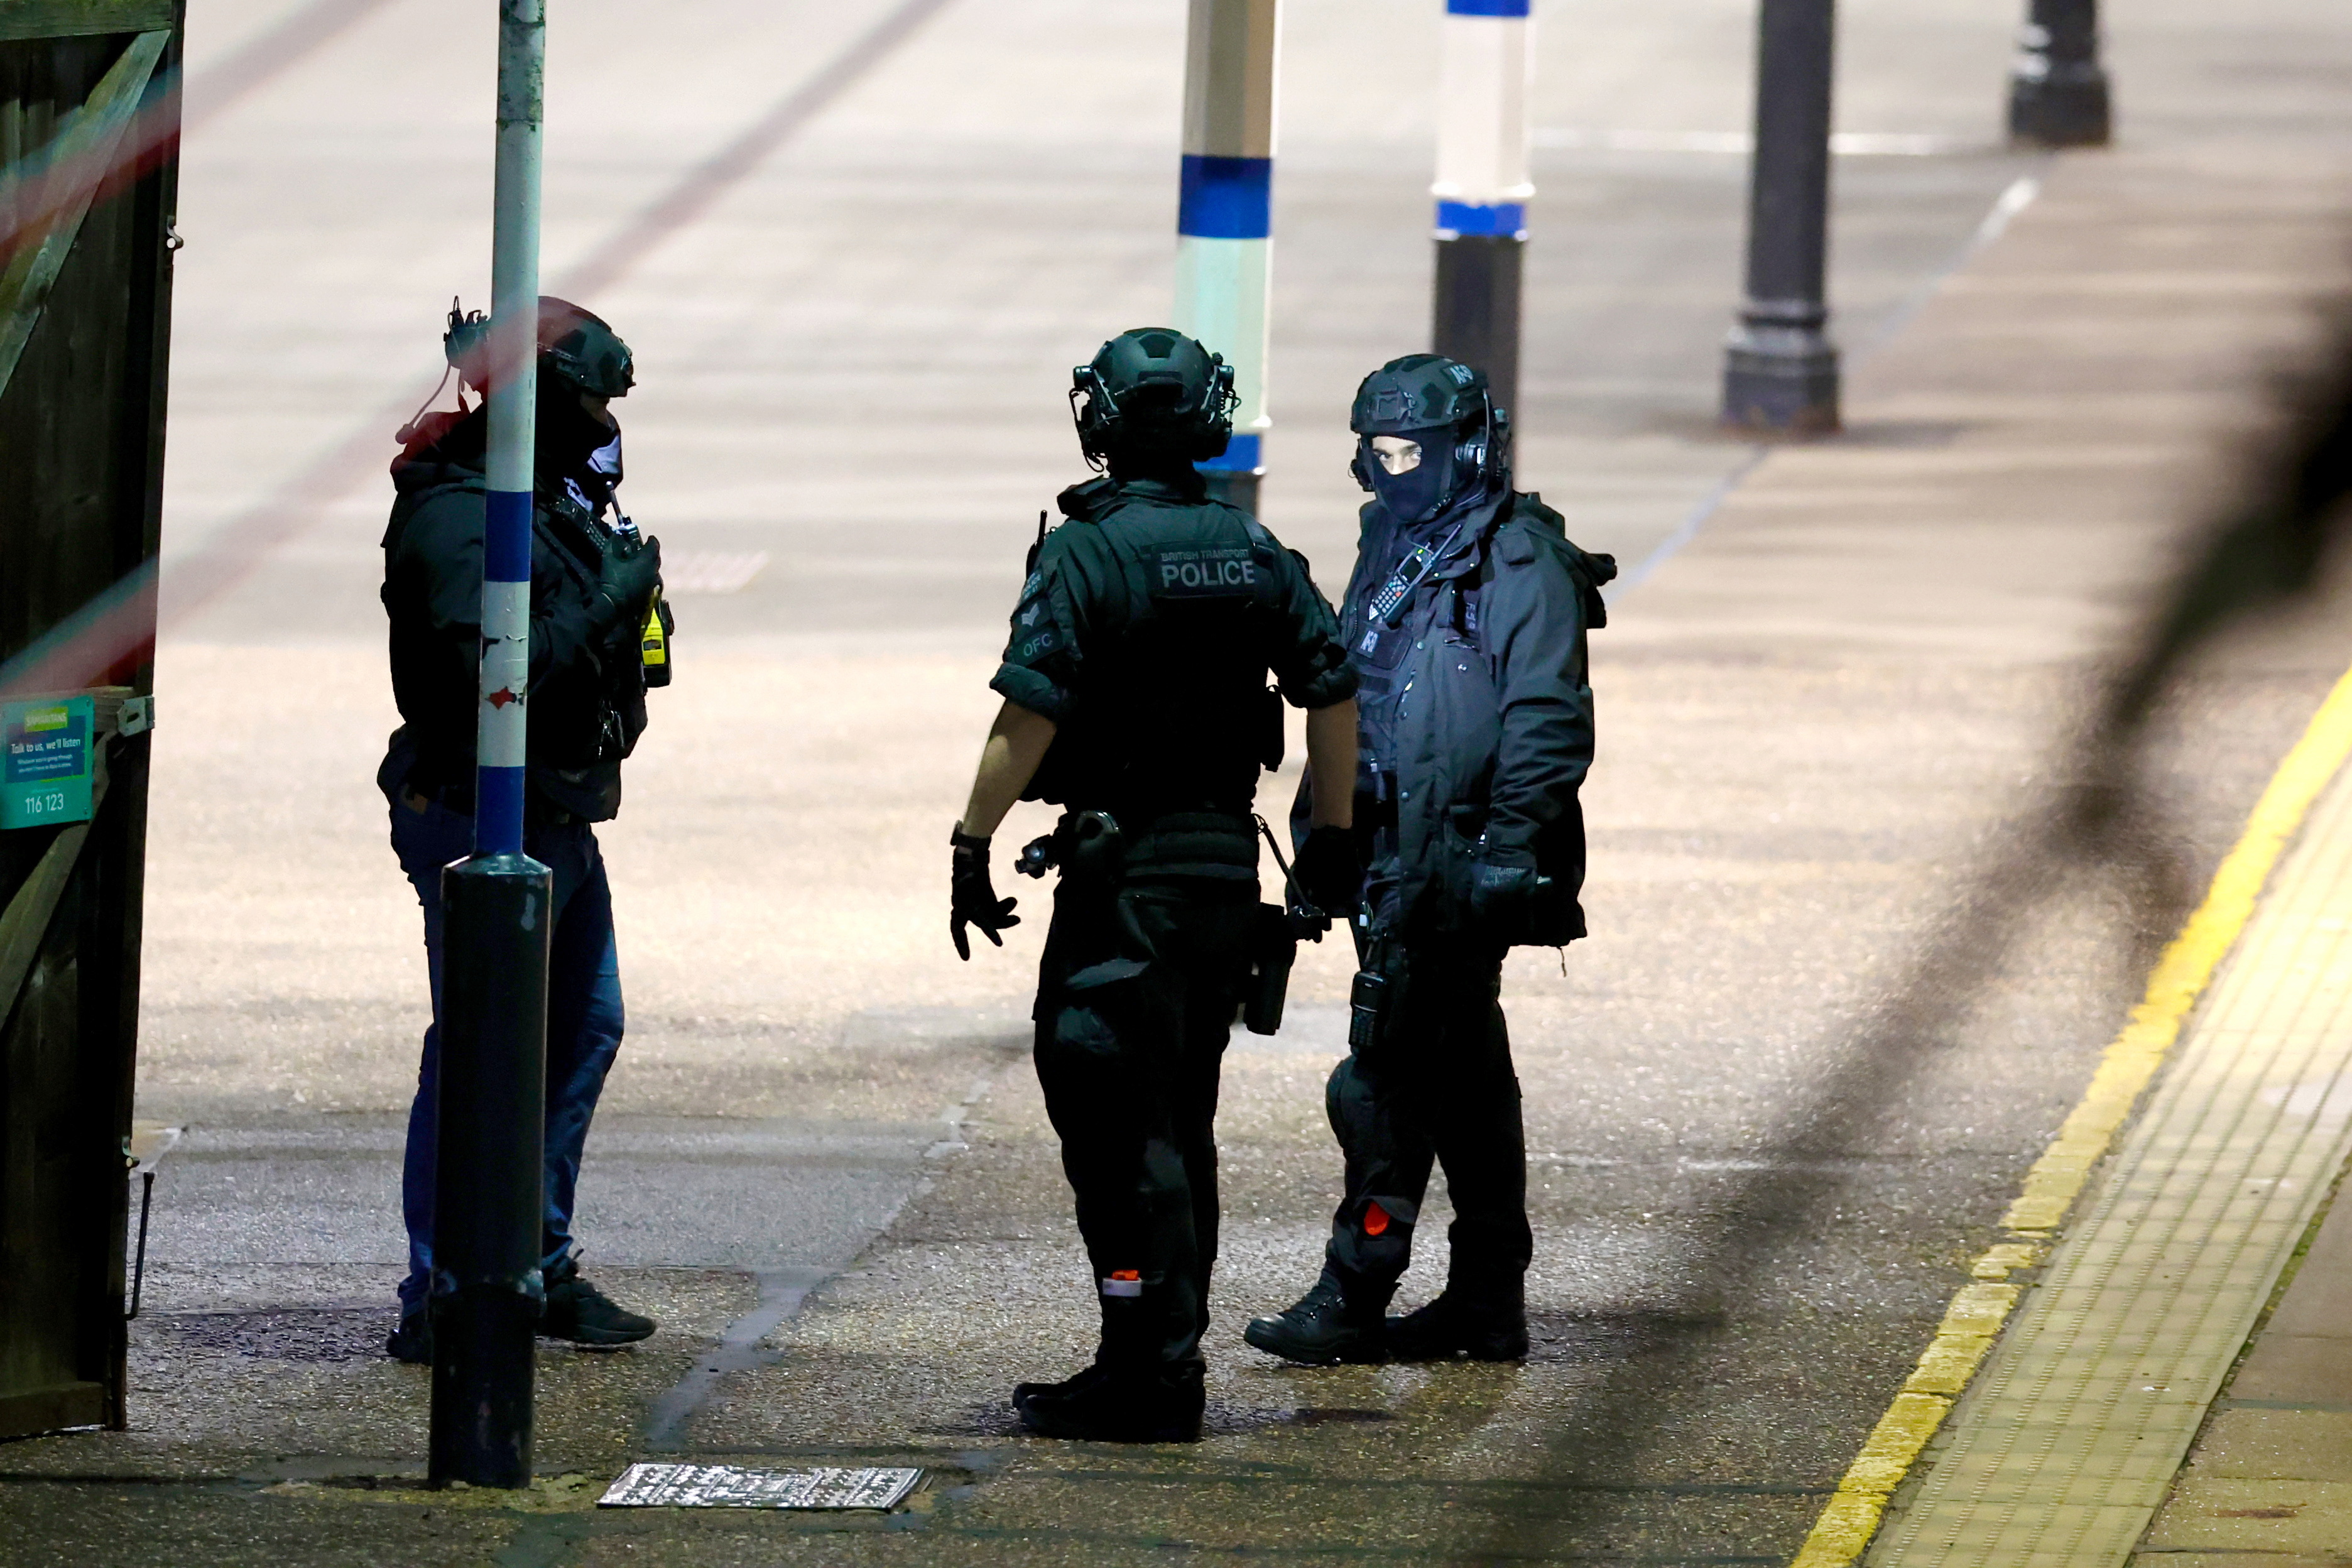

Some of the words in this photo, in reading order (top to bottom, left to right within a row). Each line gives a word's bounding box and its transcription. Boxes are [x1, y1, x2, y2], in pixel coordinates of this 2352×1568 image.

[1161, 551, 1199, 562] BRITISH
[1201, 548, 1249, 559] TRANSPORT
[1161, 560, 1256, 588] POLICE
[1023, 633, 1053, 656] OFC
[11, 743, 24, 754] Talk
[26, 743, 34, 753] to
[35, 743, 44, 752] us,
[46, 738, 62, 749] we'll
[63, 738, 80, 748] listen
[25, 796, 42, 814] 116
[46, 793, 63, 811] 123
